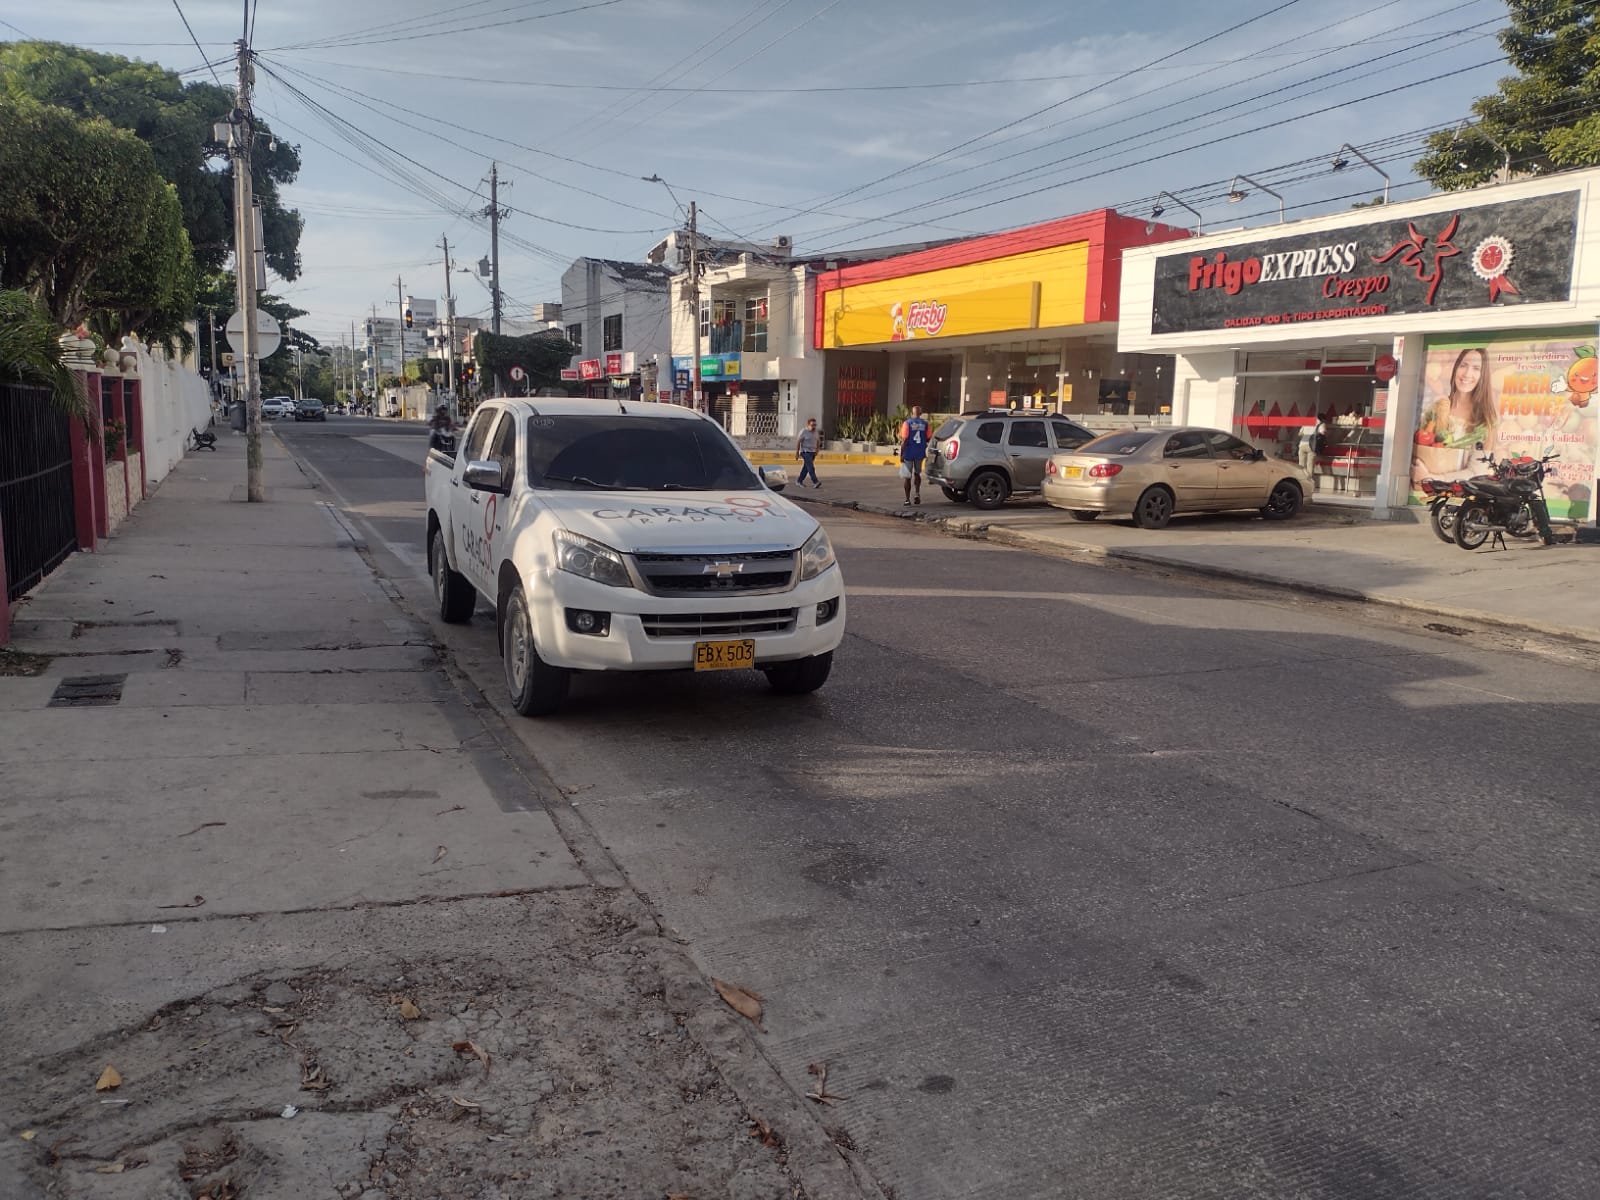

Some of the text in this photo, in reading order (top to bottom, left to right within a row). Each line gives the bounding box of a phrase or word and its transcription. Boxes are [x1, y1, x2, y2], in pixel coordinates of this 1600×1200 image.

[1322, 274, 1390, 303] Crespo
[906, 299, 948, 336] Frisby
[1224, 314, 1262, 327] CALIDAD
[1263, 313, 1280, 324] 100
[1293, 309, 1314, 321] TIPO
[1502, 374, 1550, 394] MEGA
[913, 430, 921, 444] 4
[1551, 433, 1585, 443] Calidad
[592, 504, 787, 519] CARACOL
[640, 516, 755, 525] RADIO
[697, 645, 752, 663] EBX 503
